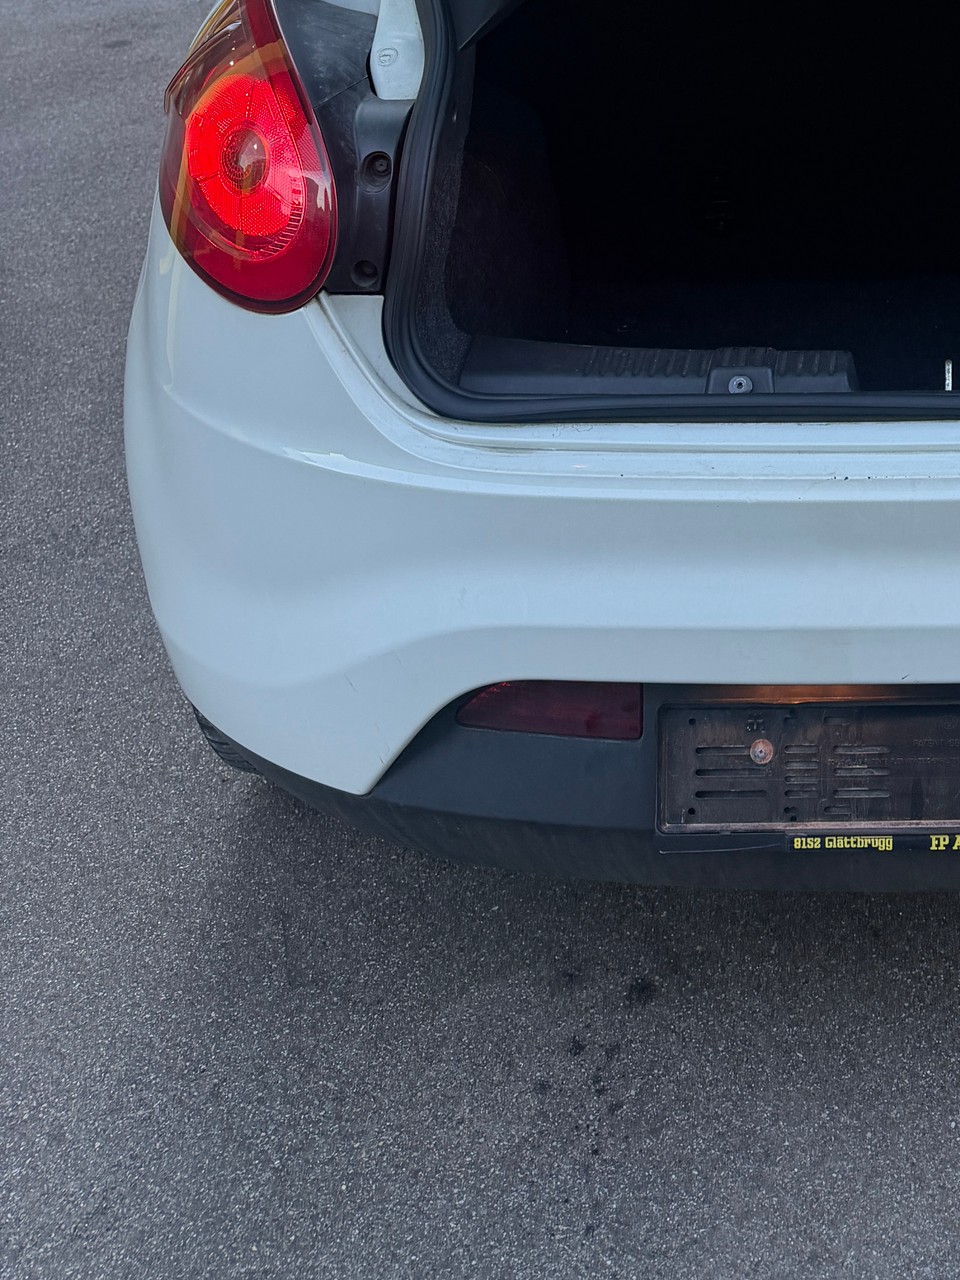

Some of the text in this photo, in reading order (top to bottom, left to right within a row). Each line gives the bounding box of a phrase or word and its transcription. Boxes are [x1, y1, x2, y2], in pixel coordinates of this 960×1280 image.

[793, 835, 894, 851] 8152 Glattbrugg
[929, 834, 950, 851] FP
